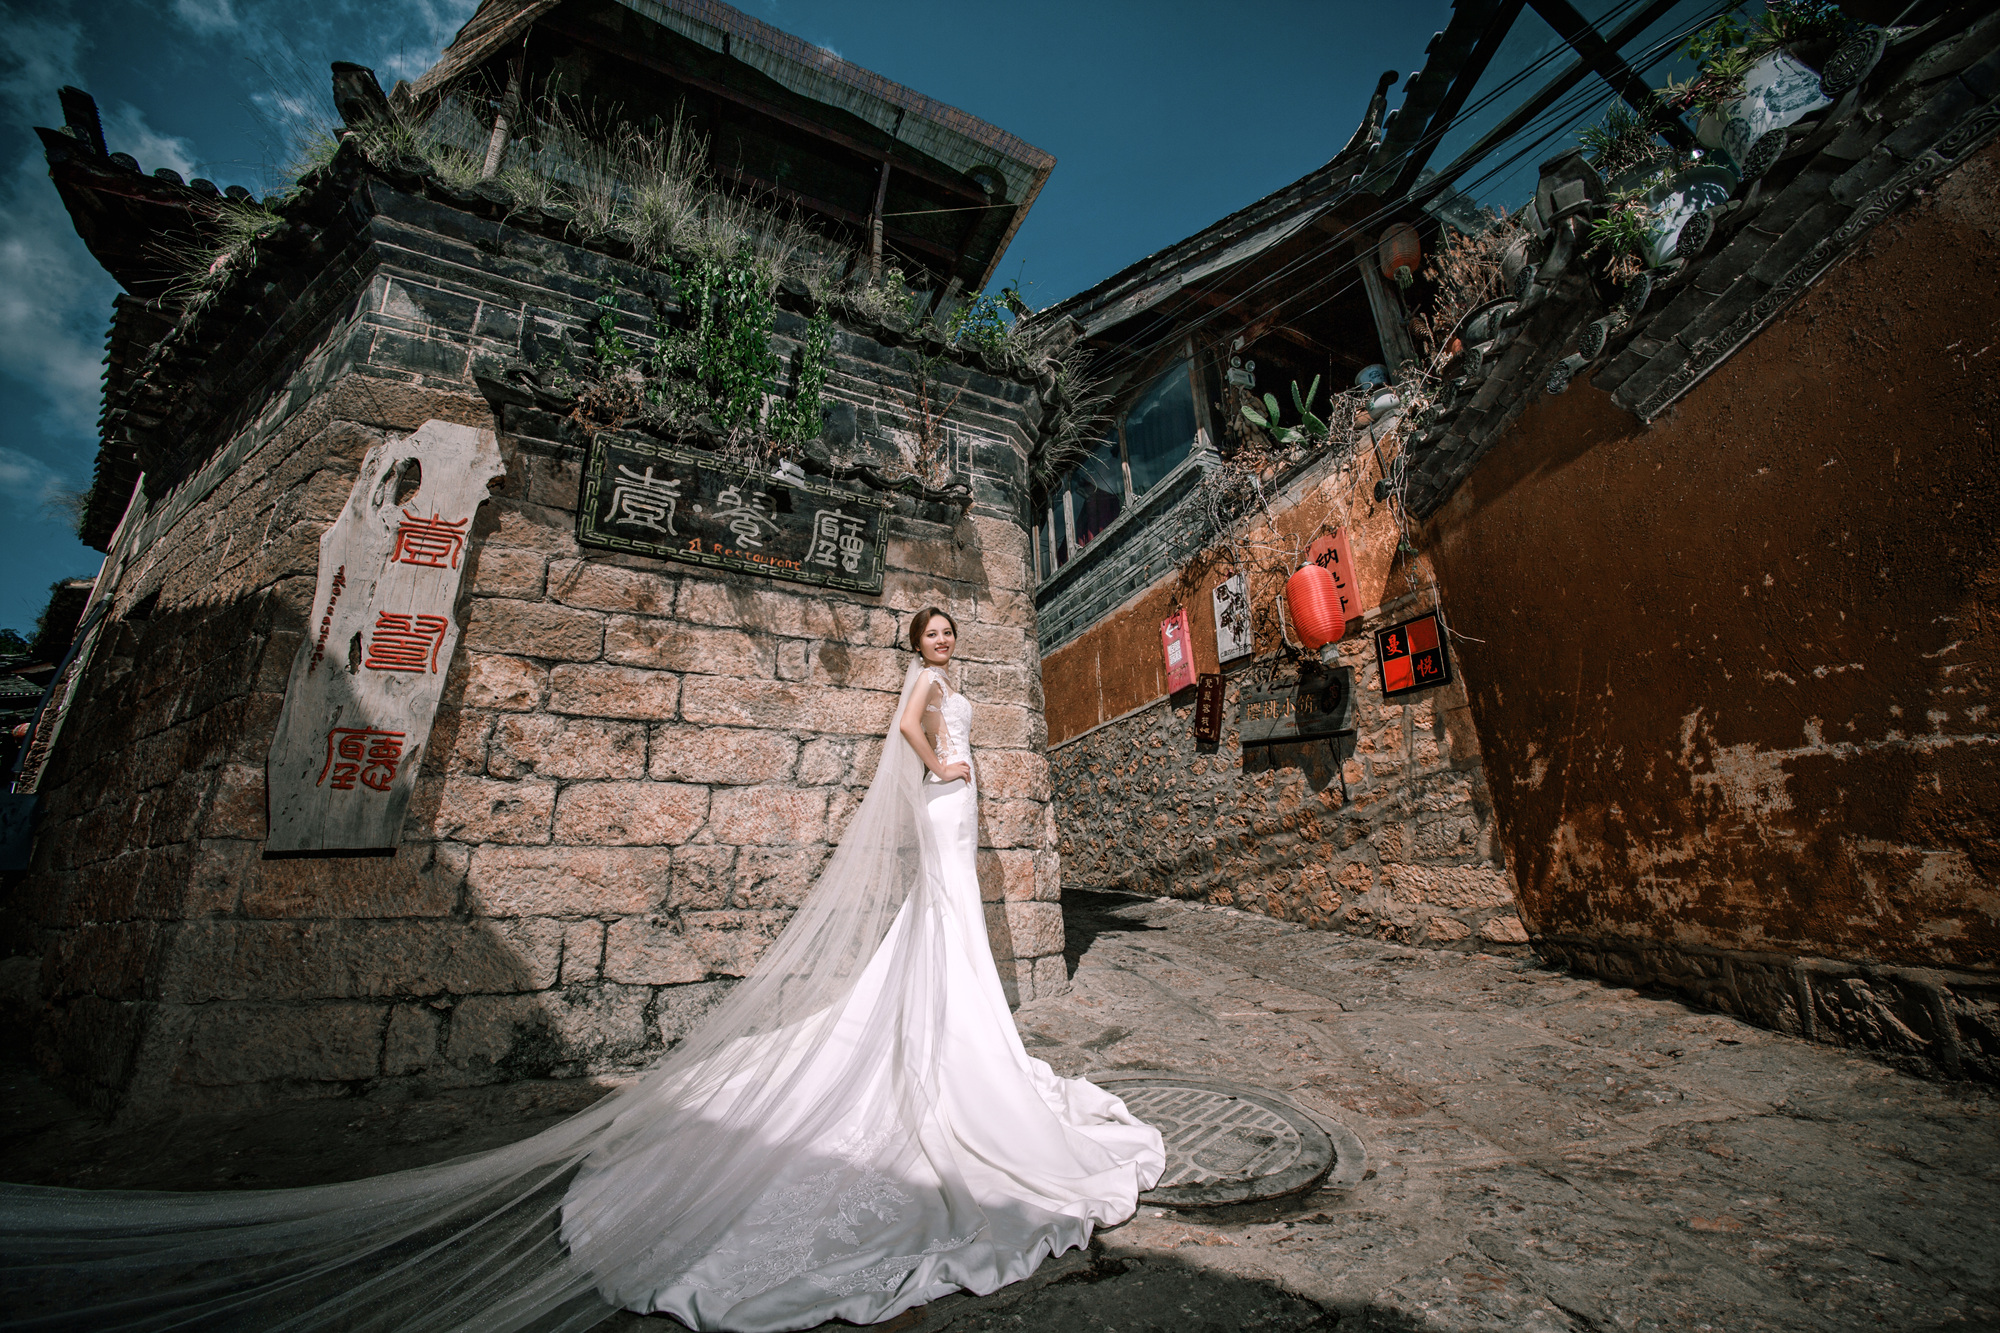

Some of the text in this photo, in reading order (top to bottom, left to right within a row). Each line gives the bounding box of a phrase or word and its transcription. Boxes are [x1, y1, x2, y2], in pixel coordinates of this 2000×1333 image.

[713, 543, 802, 571] Restaurant
[1245, 694, 1317, 721] 樱桃小筑
